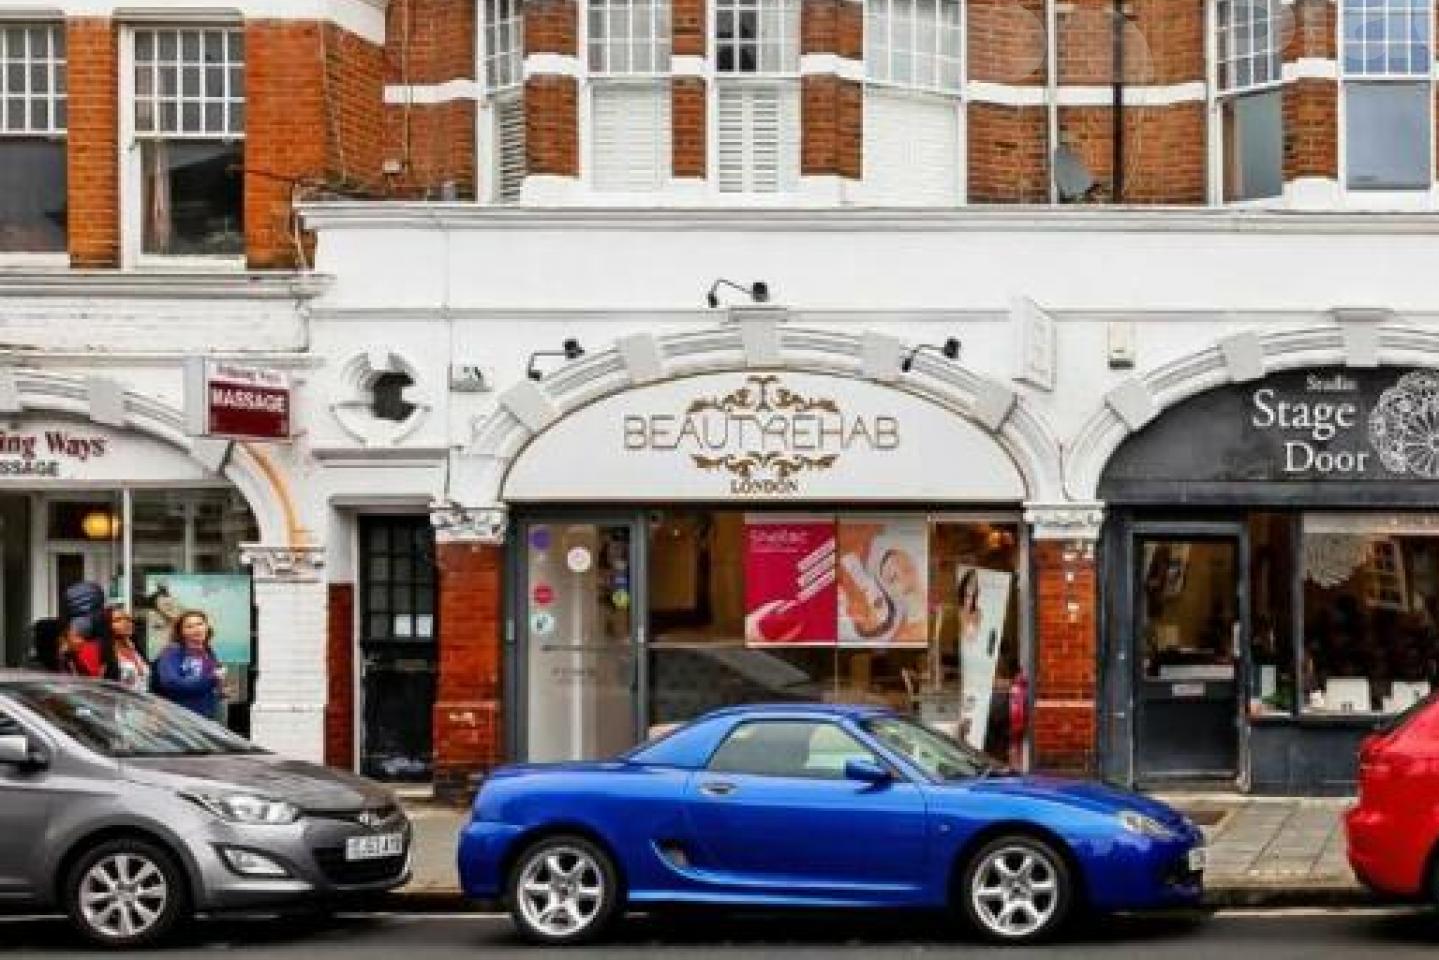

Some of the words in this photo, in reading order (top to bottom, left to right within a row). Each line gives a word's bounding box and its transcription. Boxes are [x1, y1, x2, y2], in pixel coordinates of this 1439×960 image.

[213, 388, 285, 412] MASSAGE
[1253, 389, 1356, 440] Stage
[45, 431, 105, 462] Ways
[1283, 442, 1369, 472] Door
[730, 478, 799, 494] LONDON
